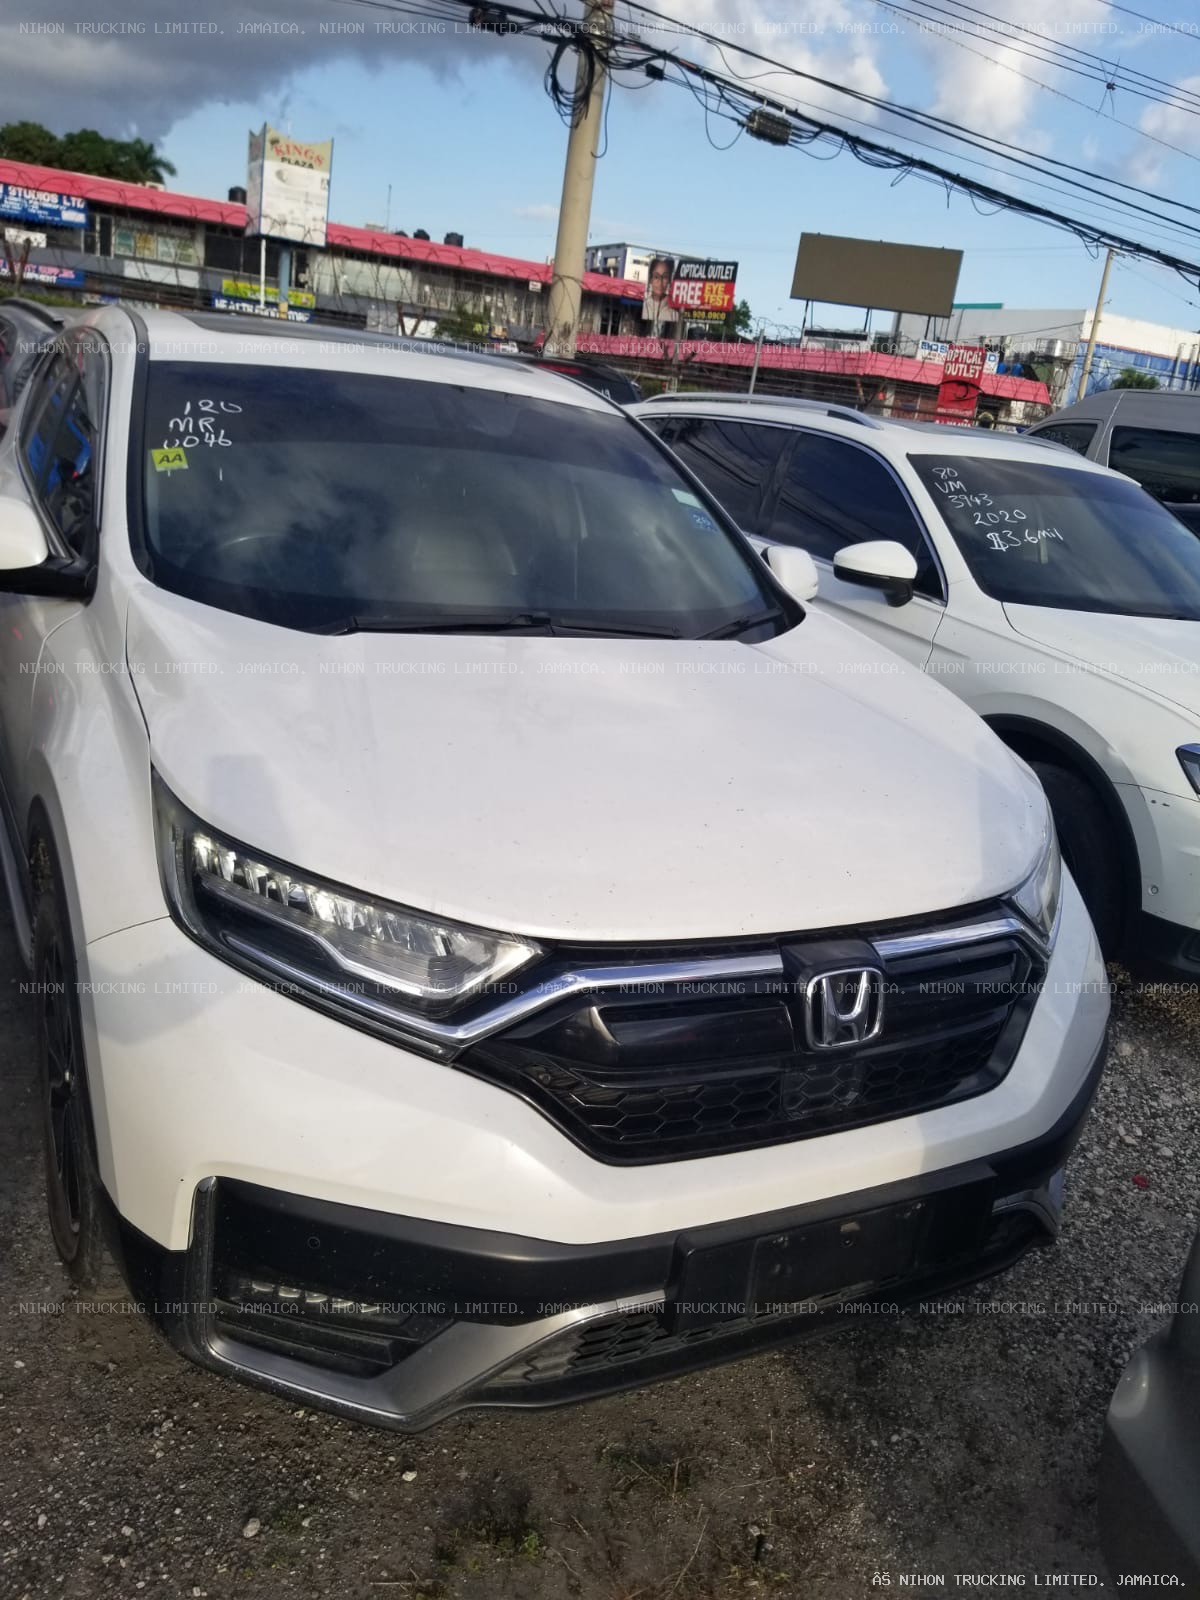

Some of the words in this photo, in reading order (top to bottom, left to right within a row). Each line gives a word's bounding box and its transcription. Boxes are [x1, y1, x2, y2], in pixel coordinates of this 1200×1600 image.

[273, 143, 325, 166] KINGS
[280, 156, 314, 169] PLAZA
[63, 195, 86, 209] LTD
[680, 263, 706, 278] OPTICAL
[707, 265, 735, 280] OUTLET
[672, 281, 703, 305] FREE
[704, 281, 726, 296] EYE
[704, 294, 730, 307] TEST
[946, 349, 984, 365] OPTICAL
[944, 362, 983, 379] OUTLET
[169, 416, 216, 433] MR
[158, 453, 184, 465] AA
[973, 509, 1028, 526] 2020
